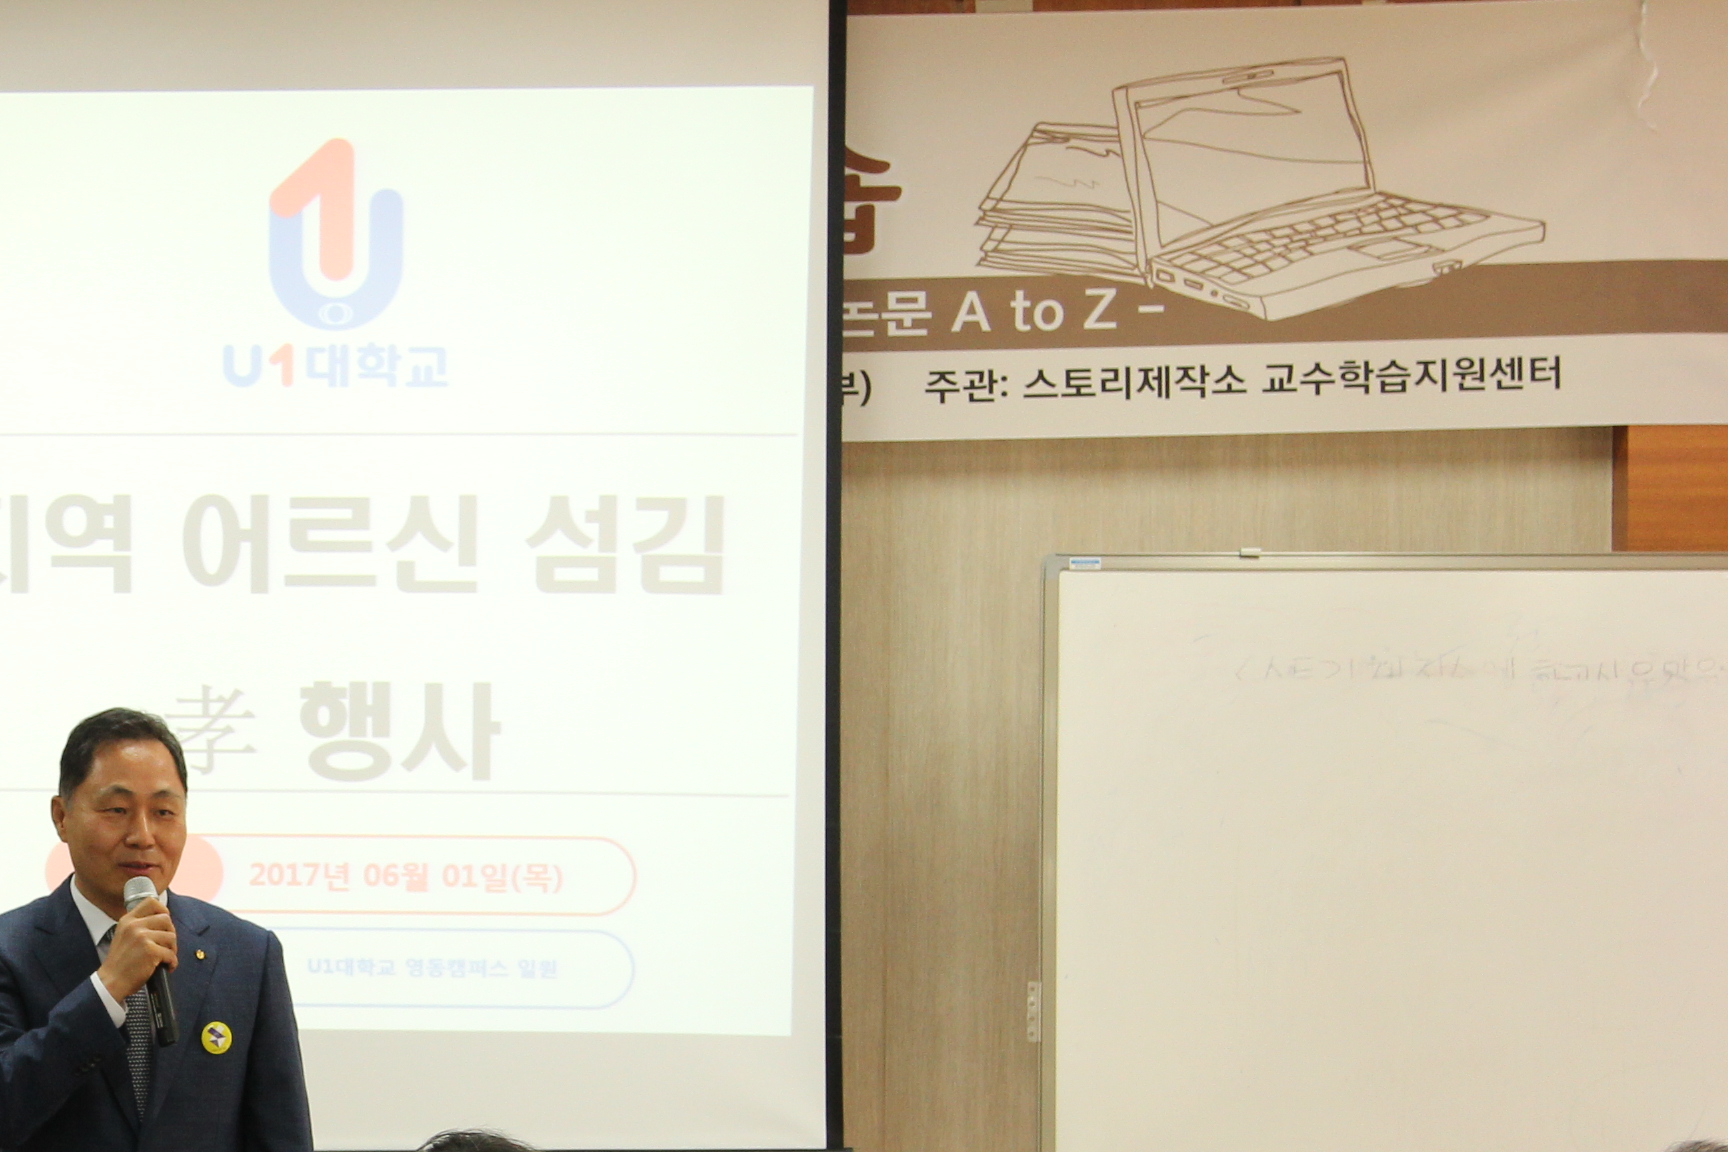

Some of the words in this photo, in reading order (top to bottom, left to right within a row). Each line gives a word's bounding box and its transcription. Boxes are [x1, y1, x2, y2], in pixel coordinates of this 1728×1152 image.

[951, 289, 992, 333] A
[1010, 289, 1065, 332] to
[1083, 287, 1118, 330] Z
[222, 341, 449, 389] U1대학교
[924, 368, 1009, 405] 주관:
[1023, 364, 1248, 401] 스토리제작소
[1262, 355, 1561, 396] 교수학습지원센터
[181, 492, 479, 595] 어르신
[524, 493, 726, 596] 섬김
[165, 683, 257, 775] 孝
[299, 679, 502, 783] 행사
[248, 861, 350, 893] 2017년
[363, 861, 429, 893] 06월
[441, 862, 564, 894] 01일(목)
[306, 957, 396, 978] U1대학교
[404, 957, 510, 979] 영동캠퍼스
[516, 958, 558, 980] 일원
